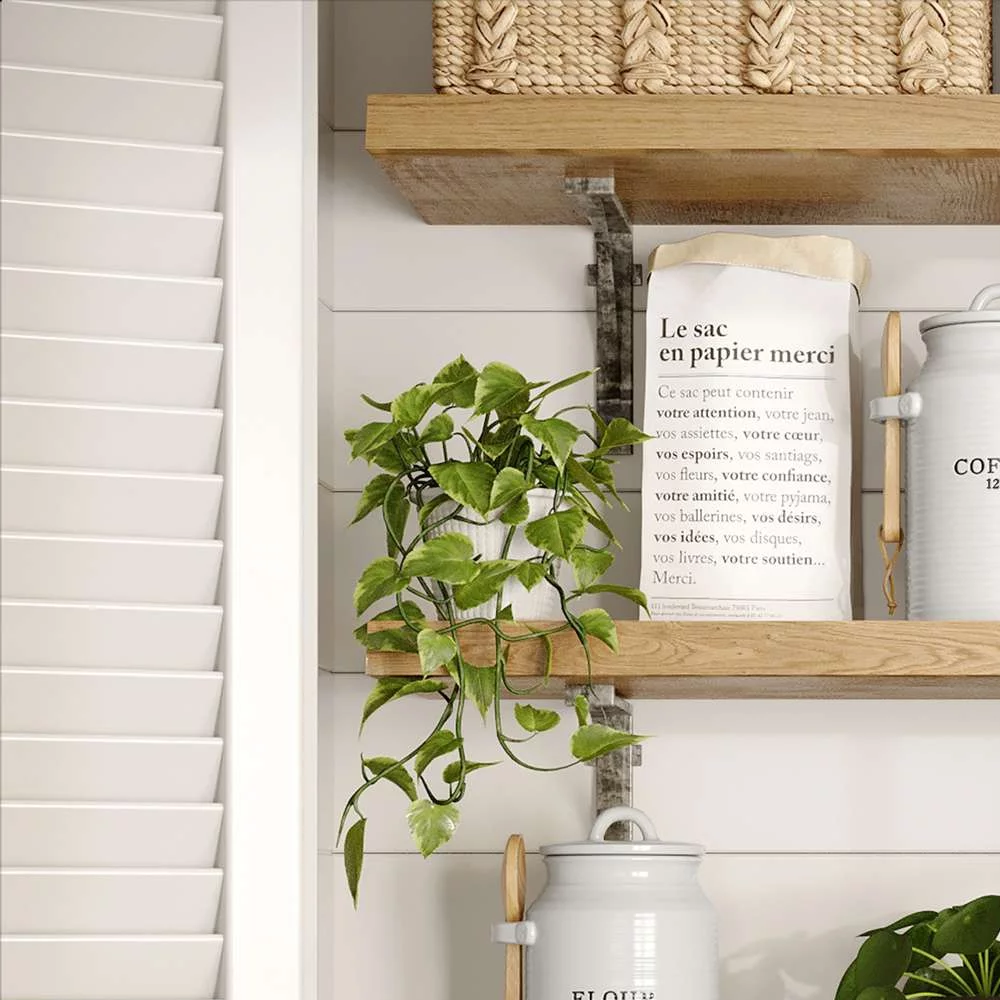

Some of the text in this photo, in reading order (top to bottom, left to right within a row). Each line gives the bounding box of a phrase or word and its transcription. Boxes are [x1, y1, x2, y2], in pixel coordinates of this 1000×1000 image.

[660, 317, 728, 338] Le sac
[659, 341, 835, 369] en papier merci
[658, 384, 795, 402] Ce sac peut contenir
[657, 405, 835, 425] votre attention, votre jean,
[656, 426, 823, 443] vos assiettes, votre cœur,
[656, 447, 823, 467] vos espoirs, vos santiags,
[655, 466, 832, 486] vos fleurs, votre confiance,
[986, 478, 1000, 490] 12
[655, 488, 832, 508] votre amitié, votre pyjama,
[654, 508, 822, 527] vos ballerines, vos désirs,
[653, 528, 802, 550] vos idées, vos disques,
[653, 554, 674, 564] vos
[679, 549, 717, 566] livres,
[722, 554, 758, 565] votre
[653, 570, 697, 585] Merci.
